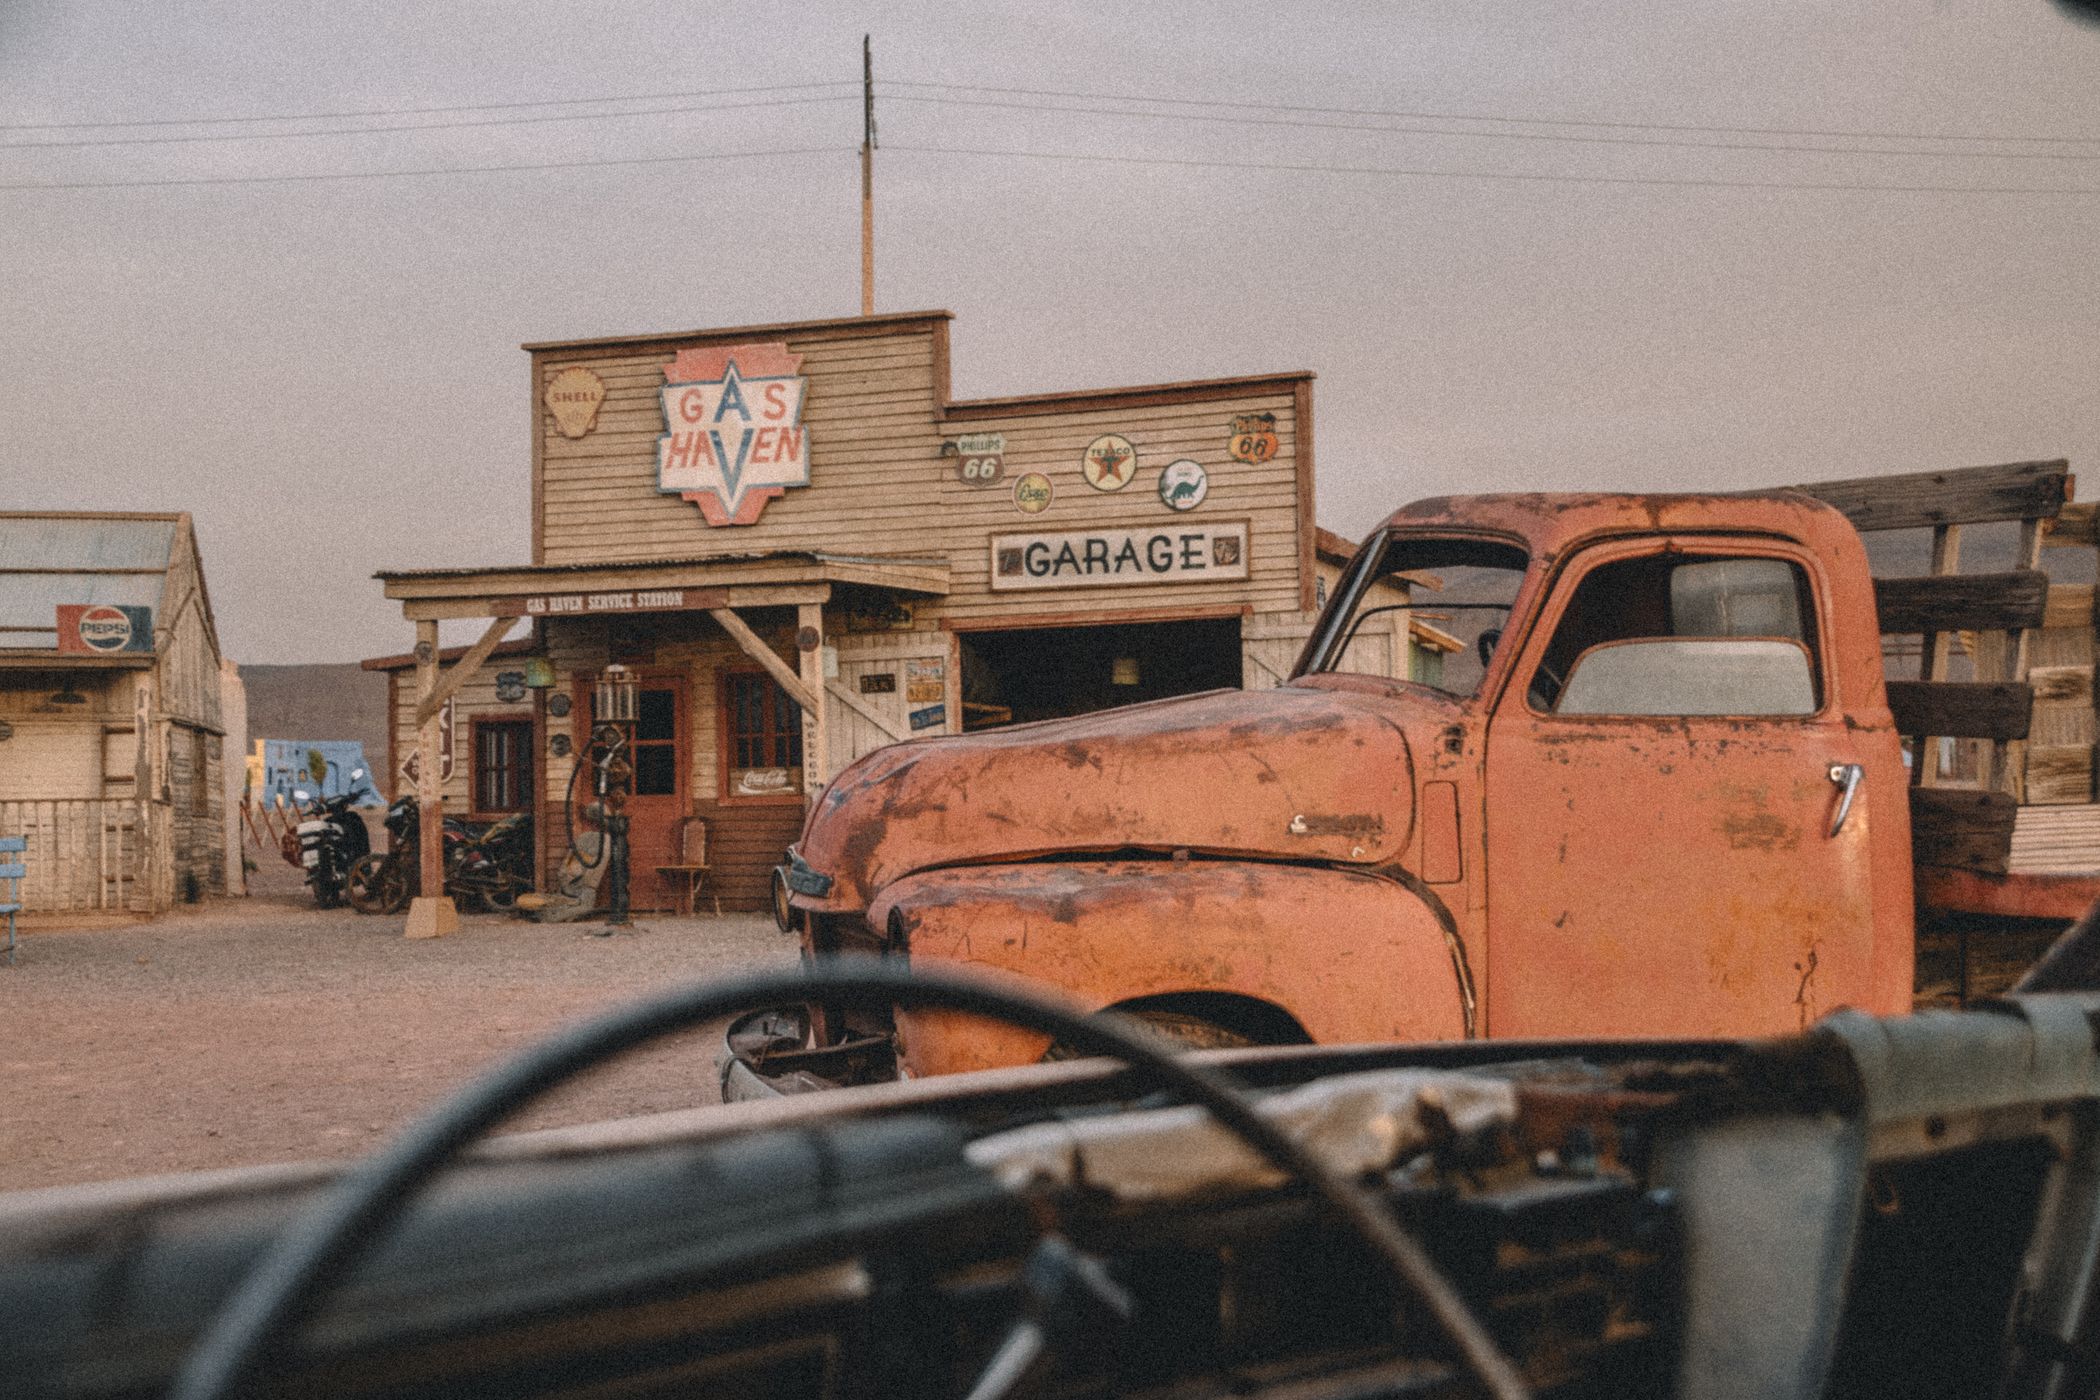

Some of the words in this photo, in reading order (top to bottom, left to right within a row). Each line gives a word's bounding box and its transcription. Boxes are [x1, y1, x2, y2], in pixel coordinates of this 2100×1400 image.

[553, 391, 597, 402] SHELL
[679, 376, 787, 424] GAS
[961, 439, 1000, 451] PHILLIPS
[1091, 447, 1130, 456] TEXACO
[1240, 436, 1268, 456] 66
[665, 426, 802, 497] HAVEN
[964, 458, 997, 479] 66
[1024, 534, 1206, 577] GARAGE
[526, 598, 546, 613] GAS
[549, 596, 583, 611] HAVEN
[588, 593, 634, 610] SERVICE
[637, 591, 684, 607] STATION
[81, 622, 129, 634] PEPSI
